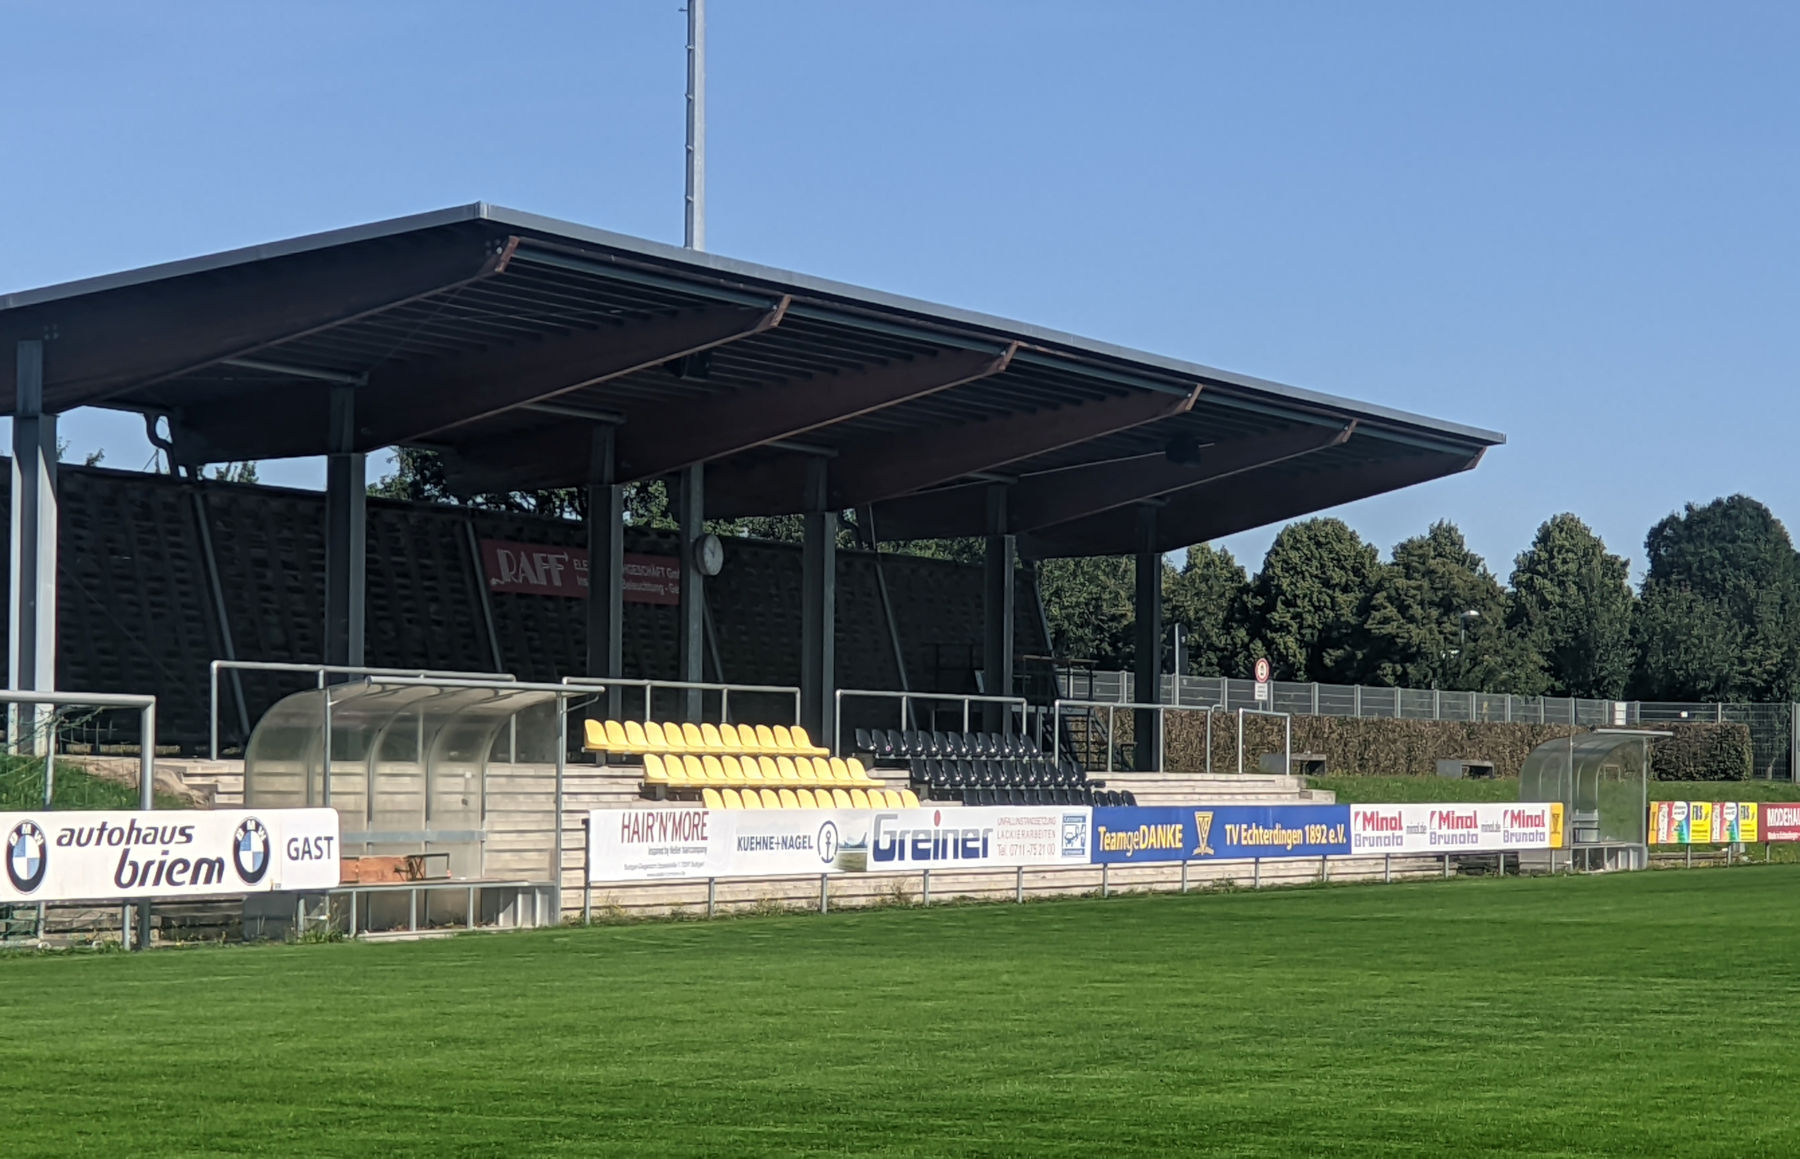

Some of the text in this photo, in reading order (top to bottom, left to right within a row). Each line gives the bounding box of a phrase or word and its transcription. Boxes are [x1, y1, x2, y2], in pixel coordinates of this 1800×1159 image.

[572, 558, 590, 571] ELE
[235, 818, 267, 842] BMW
[620, 810, 709, 843] HAIR'N'MORE
[1362, 810, 1403, 831] Minol
[1438, 809, 1479, 830] Minol
[1510, 808, 1546, 828] Minol
[9, 820, 44, 846] BMW
[56, 818, 195, 848] autohaus
[736, 833, 814, 852] KUEHNE+NAGEL
[873, 808, 993, 862] Greiner
[1097, 823, 1184, 857] TeamgeDANKE
[1225, 821, 1347, 850] TV Echterdingen 1892 e.V.
[1354, 831, 1403, 848] Brunata
[1429, 830, 1479, 846] Brunata
[1503, 828, 1546, 843] Brunata
[286, 835, 334, 861] GAST
[113, 847, 225, 889] briem
